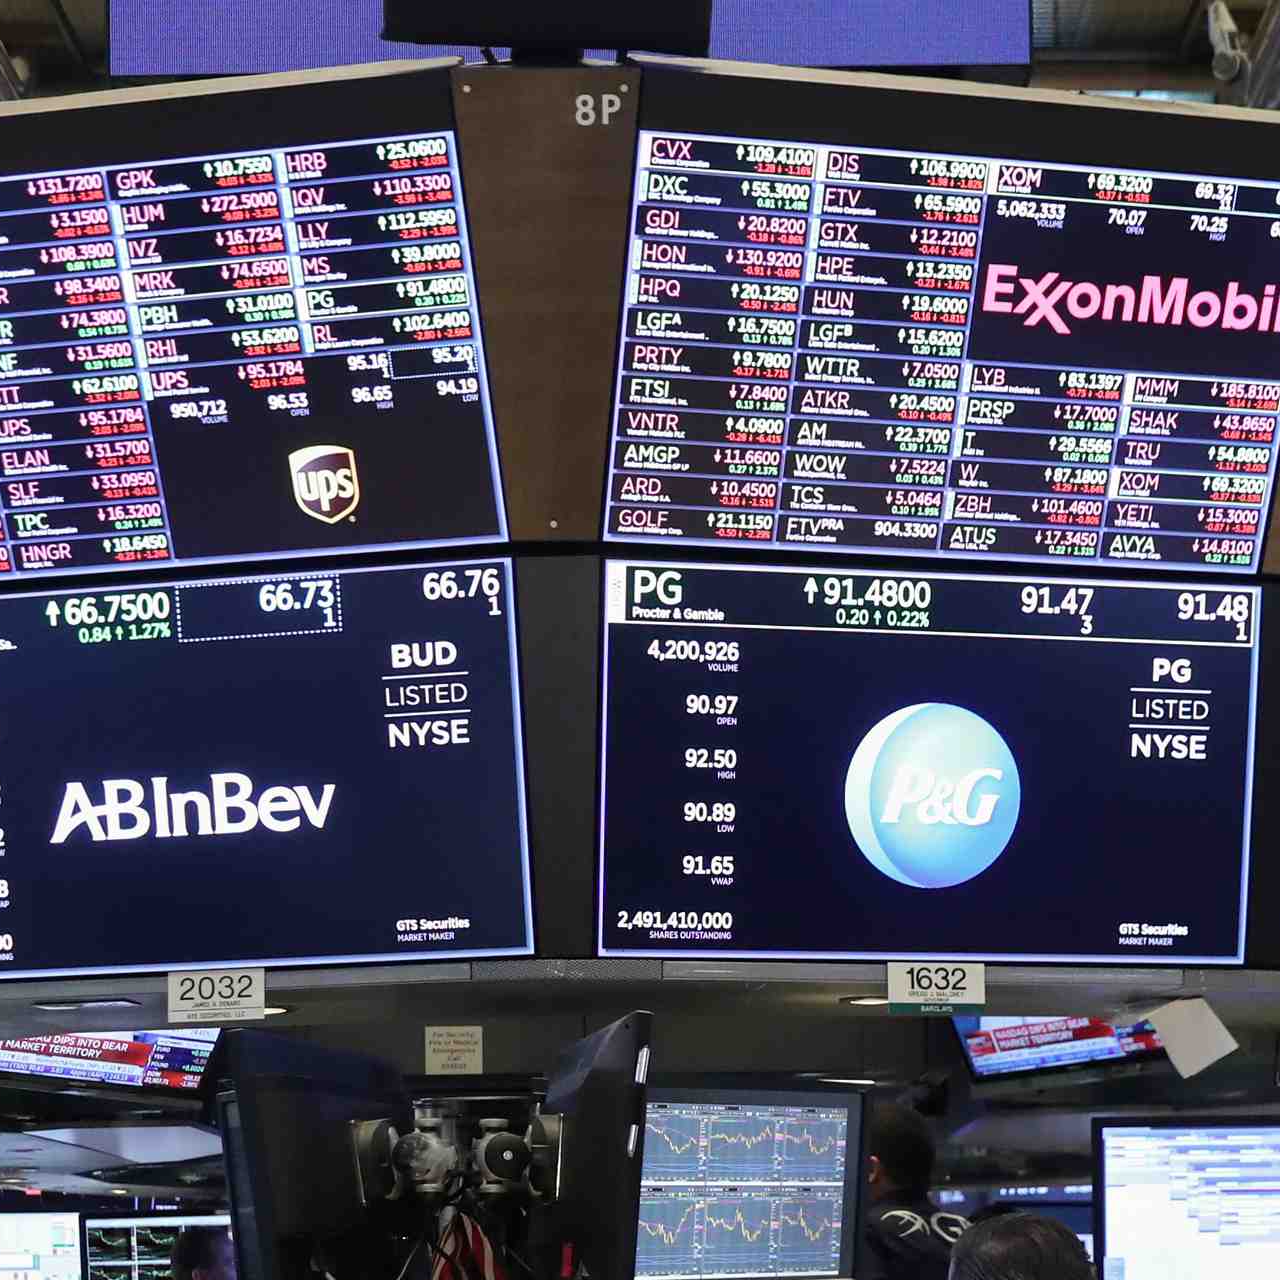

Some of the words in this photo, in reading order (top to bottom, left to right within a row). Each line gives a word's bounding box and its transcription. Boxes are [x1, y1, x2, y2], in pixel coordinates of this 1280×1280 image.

[575, 94, 621, 126] 8P
[652, 141, 693, 160] CVX
[999, 165, 1042, 188] XOM
[124, 204, 164, 223] HUM
[1108, 209, 1146, 225] 70.07
[642, 244, 686, 264] HON
[736, 251, 802, 268] 130.9200
[134, 272, 175, 290] MRK
[231, 259, 288, 277] 74.6500
[151, 371, 188, 389] UPS
[246, 361, 303, 378] 95.1784
[347, 351, 386, 371] 95.16
[268, 394, 307, 410] 96.53
[437, 378, 477, 395] 94.19
[1137, 379, 1179, 396] MMM
[1221, 383, 1280, 401] 185.8100
[628, 412, 679, 431] VNTR
[1131, 411, 1178, 429] SHAK
[2, 450, 49, 470] ELAN
[297, 468, 354, 512] ups
[950, 526, 996, 544] ATUS
[1111, 537, 1155, 553] AVYA
[65, 592, 170, 626] 66.7500
[260, 583, 334, 612] 66.73
[423, 570, 499, 600] 66.76
[632, 570, 683, 603] PG
[823, 578, 931, 609] 91.4800
[1020, 587, 1094, 614] 91.47
[1177, 593, 1249, 622] 91.48
[632, 606, 674, 620] Procter
[685, 608, 724, 621] Gamble
[836, 609, 868, 625] 0.20
[886, 610, 929, 628] 0.22%
[79, 626, 110, 643] 0.84
[128, 622, 170, 640] 1.27%
[1081, 614, 1093, 635] 3
[391, 641, 457, 668] BUD
[647, 640, 739, 663] 4,200,926
[708, 663, 738, 672] VOLUME
[1152, 658, 1192, 684] PG
[385, 683, 468, 707] LISTED
[686, 694, 738, 716] 90.97
[1131, 698, 1209, 721] LISTED
[717, 717, 737, 725] OPEN
[388, 720, 469, 748] NYSE
[1130, 735, 1207, 760] NYSE
[684, 748, 736, 769] 92.50
[717, 770, 736, 779] HIGH
[880, 767, 1003, 825] P&G
[50, 772, 335, 844] ABInBev
[684, 802, 735, 823] 90.89
[717, 824, 734, 832] LOW
[682, 856, 733, 876] 91.65
[711, 877, 733, 885] VWAP
[396, 918, 416, 932] GTS
[420, 916, 469, 929] Securities
[617, 911, 732, 931] 2,491,410,000
[1119, 922, 1138, 937] GTS
[398, 932, 426, 942] MARKET
[428, 931, 454, 940] MAKER
[649, 930, 682, 939] SHARES
[682, 931, 732, 940] OUTSTANDING
[1119, 937, 1149, 946] MARKET
[180, 975, 253, 1000] 2032
[906, 967, 967, 990] 1632
